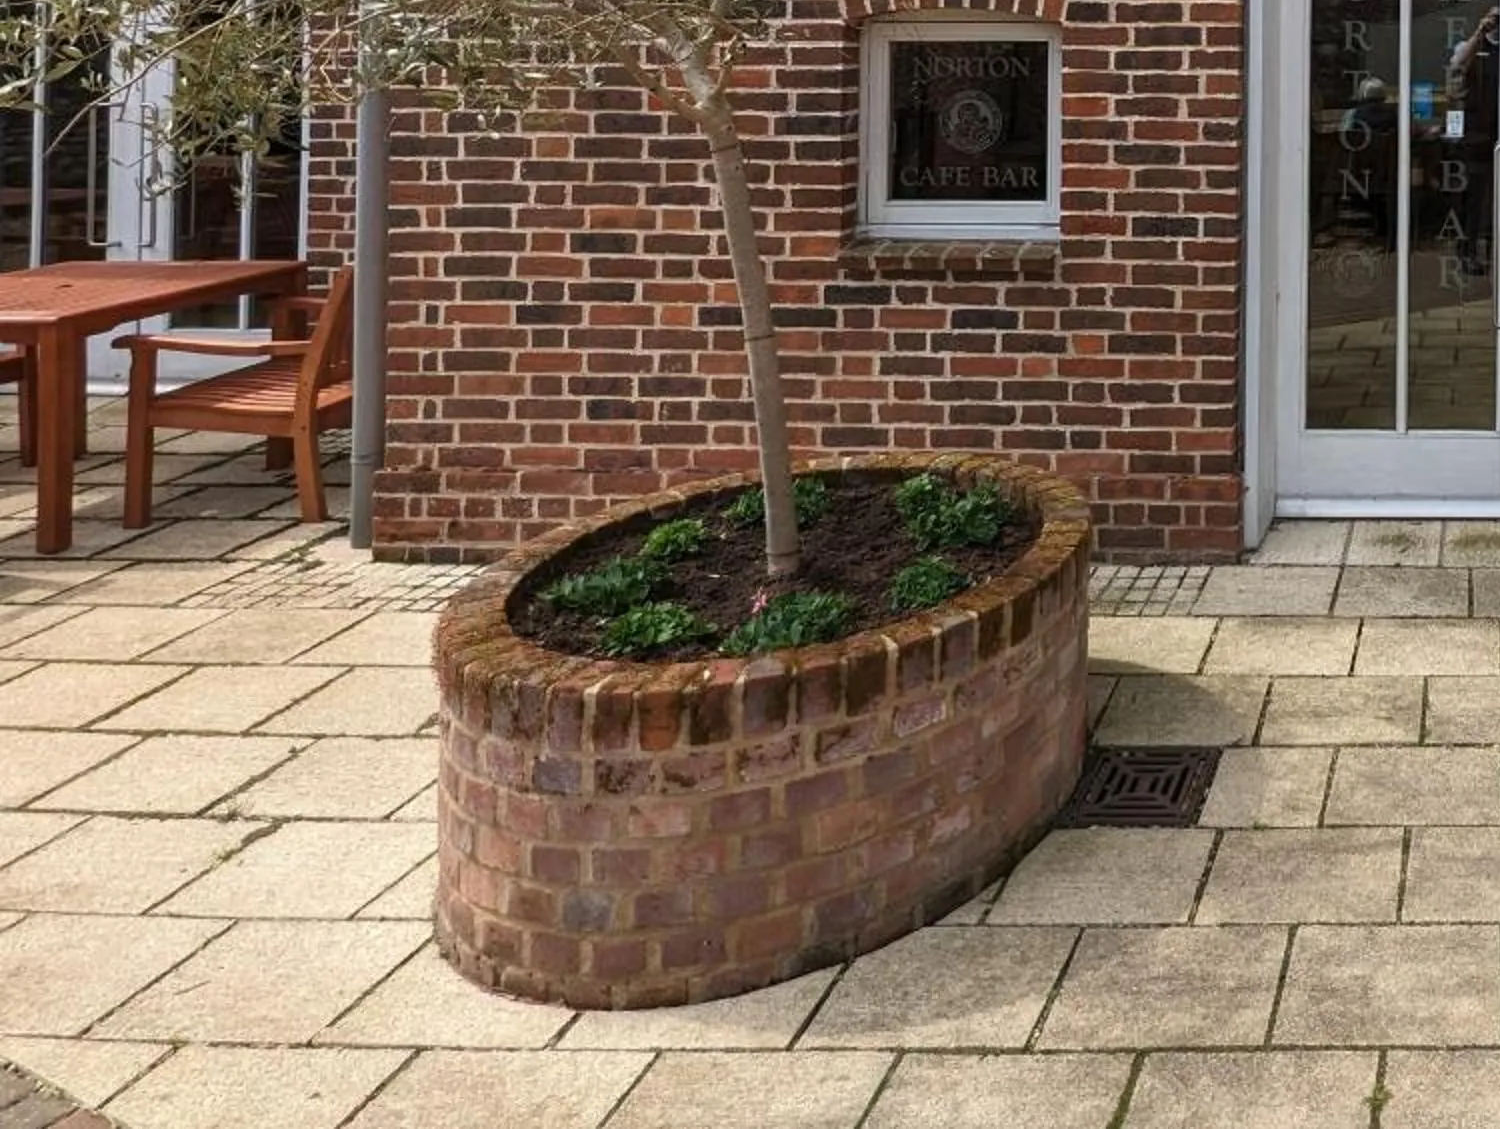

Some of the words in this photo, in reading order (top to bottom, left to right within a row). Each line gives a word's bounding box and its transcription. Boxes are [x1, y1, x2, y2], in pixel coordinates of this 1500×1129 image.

[912, 56, 1031, 78] NORTON
[899, 166, 971, 187] CAFE
[982, 166, 1040, 188] BAR
[1438, 160, 1471, 291] BAR
